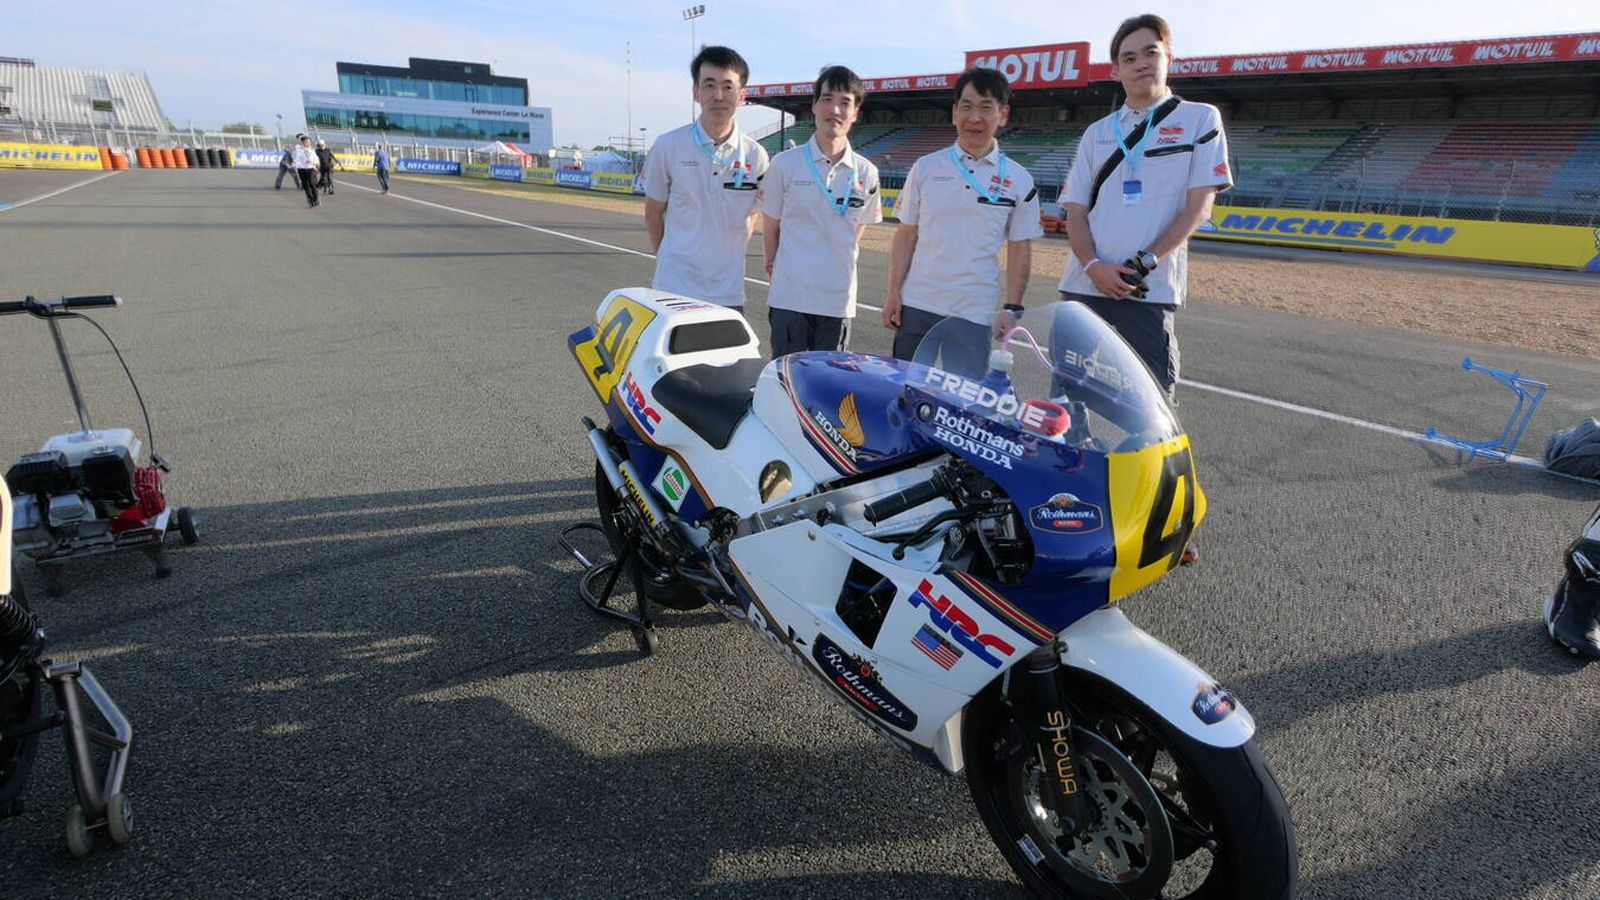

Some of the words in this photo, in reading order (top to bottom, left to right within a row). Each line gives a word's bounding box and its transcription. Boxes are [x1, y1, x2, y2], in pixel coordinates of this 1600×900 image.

[1168, 60, 1218, 73] MOTUL
[1231, 57, 1288, 72] MOTUL
[1303, 52, 1366, 68] MOTUL
[1383, 48, 1455, 65] MOTUL
[1474, 41, 1554, 60] MOTUL
[882, 80, 909, 90] MOTUL
[917, 76, 947, 87] MOTUL
[407, 161, 459, 171] MICHELIN
[1220, 213, 1456, 244] MICHELIN
[594, 307, 634, 381] 4
[622, 372, 662, 436] HRC
[925, 367, 1047, 428] FREDDIE
[815, 411, 857, 462] HONDA
[934, 407, 1025, 457] Rothmans
[934, 427, 1013, 470] HONDA
[620, 468, 655, 523] MICHELIN
[666, 473, 684, 497] Castrol
[1036, 507, 1098, 520] Rothmans
[1138, 447, 1195, 573] 4
[907, 578, 1016, 669] HRC
[824, 644, 907, 722] Rothmans
[1046, 710, 1077, 795] SHOWA
